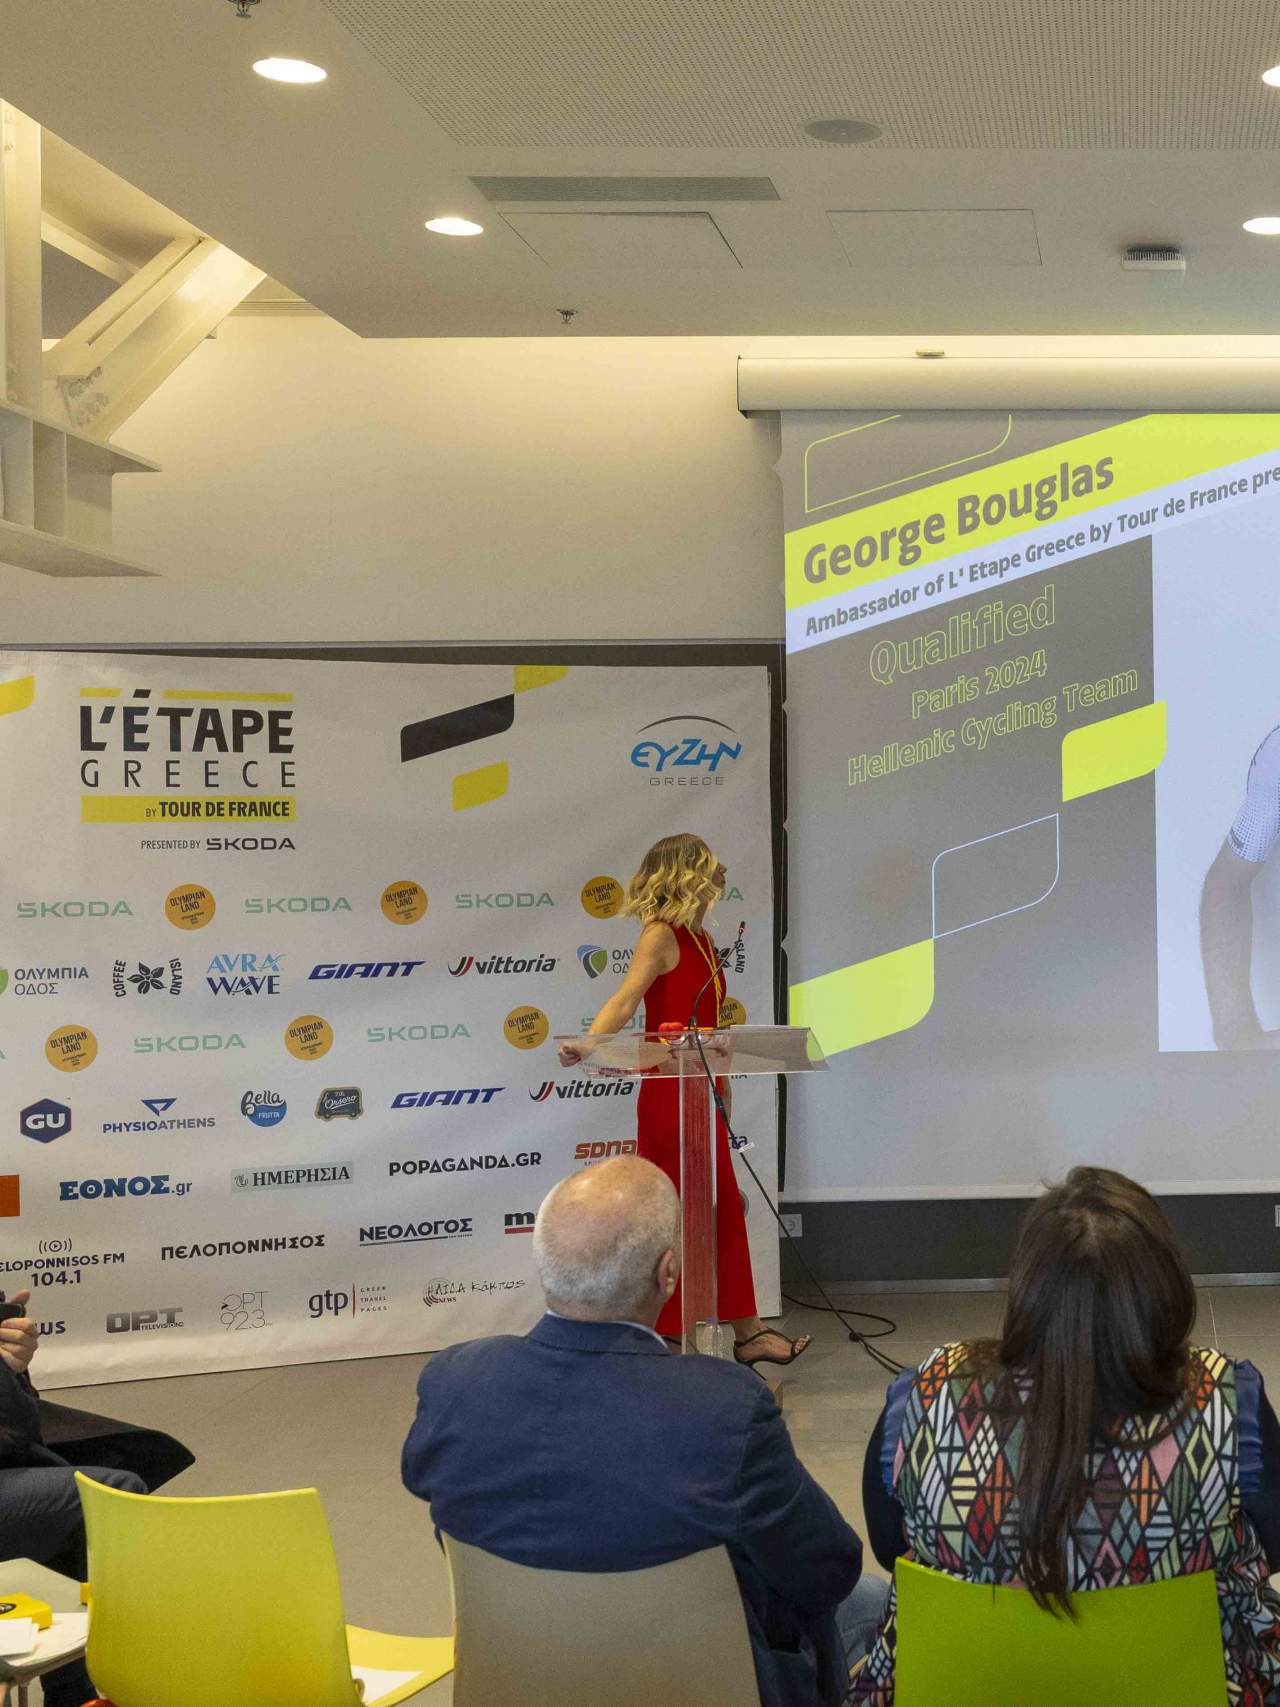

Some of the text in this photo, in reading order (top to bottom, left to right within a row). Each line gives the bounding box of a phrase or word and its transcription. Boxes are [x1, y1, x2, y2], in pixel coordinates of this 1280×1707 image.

[803, 456, 1115, 584] George Bouglas
[805, 586, 919, 636] Ambassador
[925, 573, 945, 595] of
[1025, 535, 1085, 563] Greece
[1089, 519, 1113, 543] by
[1117, 505, 1158, 533] Tour
[1163, 496, 1185, 518] de
[1189, 479, 1248, 510] France
[869, 584, 1056, 685] Qualified
[912, 649, 1048, 719] Paris 2024
[80, 688, 294, 754] L'ÉTAPE
[848, 668, 1138, 785] Hellenic Cycling Team
[80, 760, 296, 788] GREECE
[650, 776, 725, 786] GREECE
[145, 801, 290, 818] BY TOUR DE FRANCE
[141, 837, 296, 850] PRESENTED BY SKODA
[170, 890, 206, 907] OLYMPIAN
[385, 886, 418, 903] OLYMPIAN
[395, 896, 413, 908] LAND
[455, 893, 554, 909] SKODA
[17, 901, 134, 918] SKODA
[181, 901, 200, 912] LAND
[245, 897, 352, 914] SKODA
[206, 953, 286, 974] AVRA
[308, 960, 426, 980] GIANT
[475, 954, 556, 975] vittoria
[14, 966, 89, 981] ΟΛΥΜΠΙΑ
[112, 960, 127, 998] COFFEE
[169, 958, 183, 996] ISLAND
[14, 982, 59, 996] ΟΔΟΣ
[206, 975, 281, 996] WAVE
[508, 1011, 539, 1029] OLYMPIAN
[518, 1021, 535, 1033] LAND
[290, 1021, 323, 1038] OLYMPIAN
[299, 1031, 318, 1044] LAND
[367, 1024, 471, 1042] SKODA
[50, 1031, 88, 1049] OLYMPIAN
[61, 1042, 82, 1055] LAND
[134, 1034, 246, 1053] SKODA
[391, 1087, 506, 1109] GIANT
[555, 1079, 634, 1099] vittoria
[25, 1113, 65, 1129] GU
[103, 1117, 216, 1133] PHYSIOATHENS
[252, 1166, 350, 1187] ΗΜΕΡΗΣΙΑ
[360, 1218, 472, 1242] ΝΕΟΛΟΓΟΣ
[161, 1234, 326, 1261] ΠΕΛΟΠΟΝΝΗΣΟΣ
[103, 1252, 125, 1264] FM
[31, 1269, 81, 1287] 104.1
[308, 1289, 349, 1318] gtp
